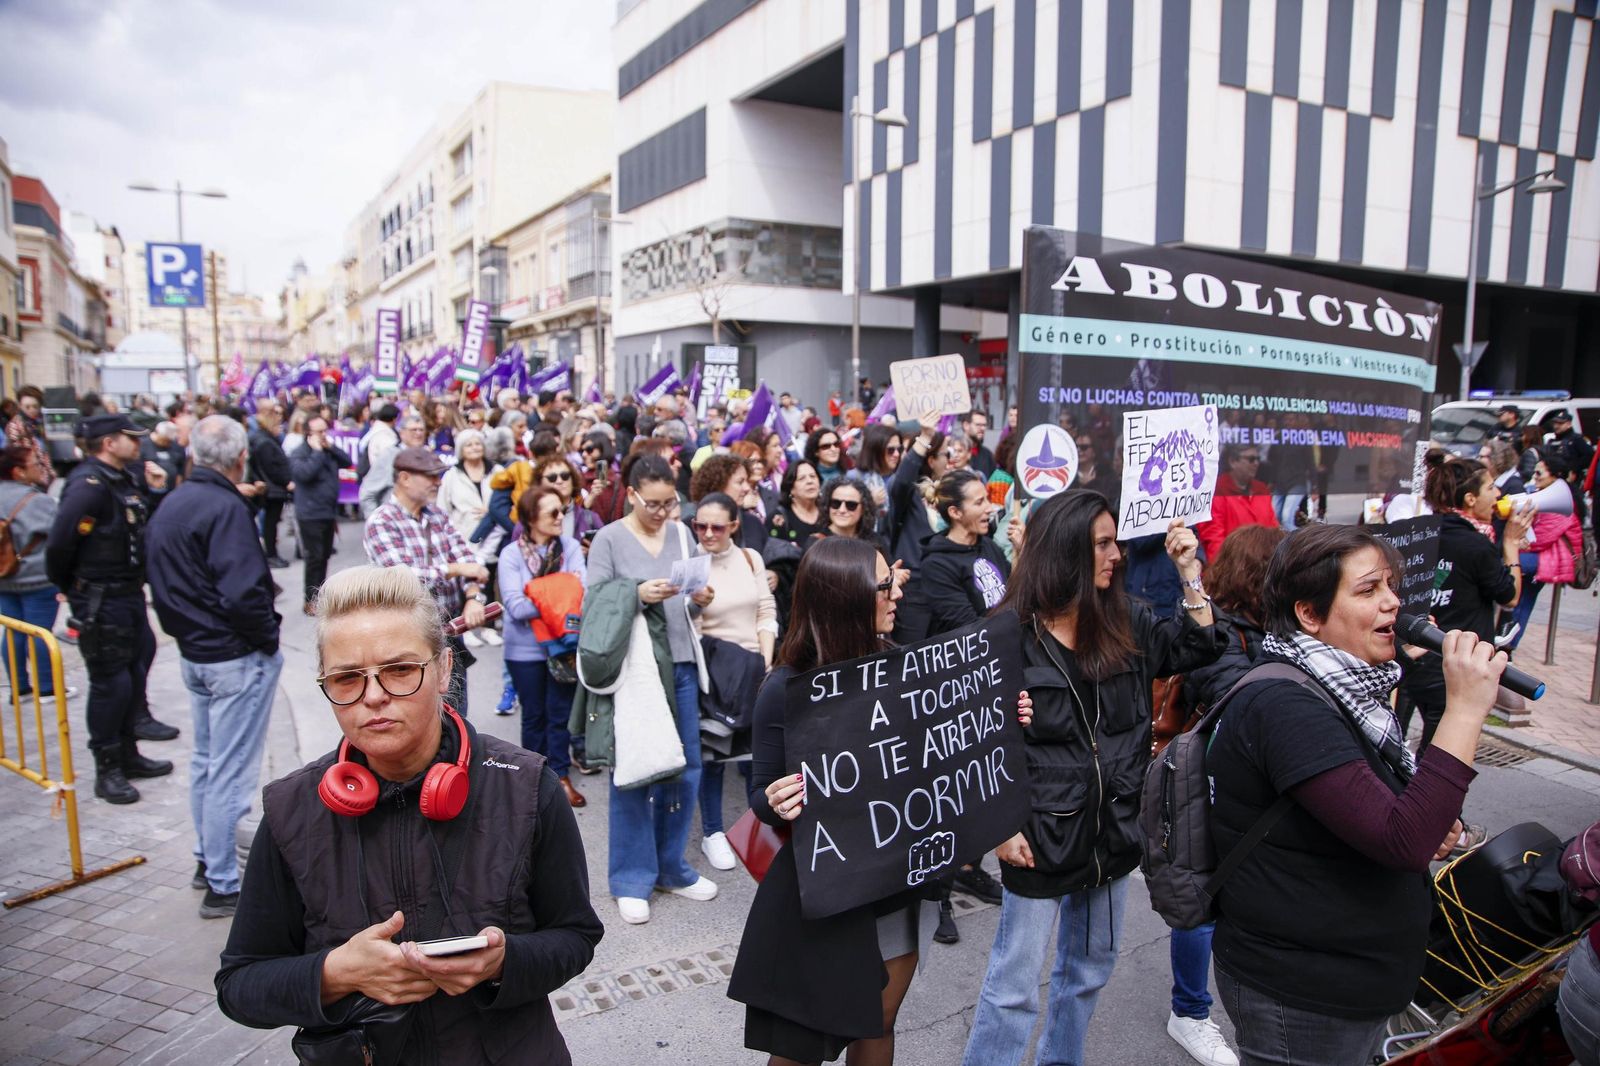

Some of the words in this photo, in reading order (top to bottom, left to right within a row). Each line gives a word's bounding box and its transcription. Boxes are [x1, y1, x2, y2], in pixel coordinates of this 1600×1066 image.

[151, 246, 187, 286] P
[1031, 326, 1107, 346] Género
[1130, 332, 1242, 357] Prostitución
[1260, 345, 1342, 367] Pornografía
[1350, 355, 1398, 375] Vientres
[900, 360, 958, 387] PORNO
[1039, 386, 1056, 403] SI
[1059, 387, 1082, 404] NO
[1086, 388, 1144, 406] LUCHAS
[1147, 390, 1200, 407] CONTRA
[1201, 392, 1240, 410] TODAS
[1242, 395, 1265, 411] LAS
[1265, 395, 1328, 415] VIOLENCIAS
[1328, 400, 1358, 416] HACIA
[1359, 402, 1375, 418] LAS
[1127, 415, 1157, 441] EL
[1253, 428, 1279, 445] DEL
[1282, 430, 1346, 448] PROBLEMA
[1170, 462, 1187, 483] ES
[810, 669, 844, 702] SI
[857, 658, 889, 692] TE
[901, 628, 990, 682] ATREVES
[870, 699, 890, 732] A
[900, 658, 1003, 720] TOCARME
[801, 750, 860, 806] NO
[868, 735, 910, 780] TE
[922, 696, 1005, 769] ATREVAS
[810, 820, 847, 873] A
[868, 746, 1015, 849] DORMIR
